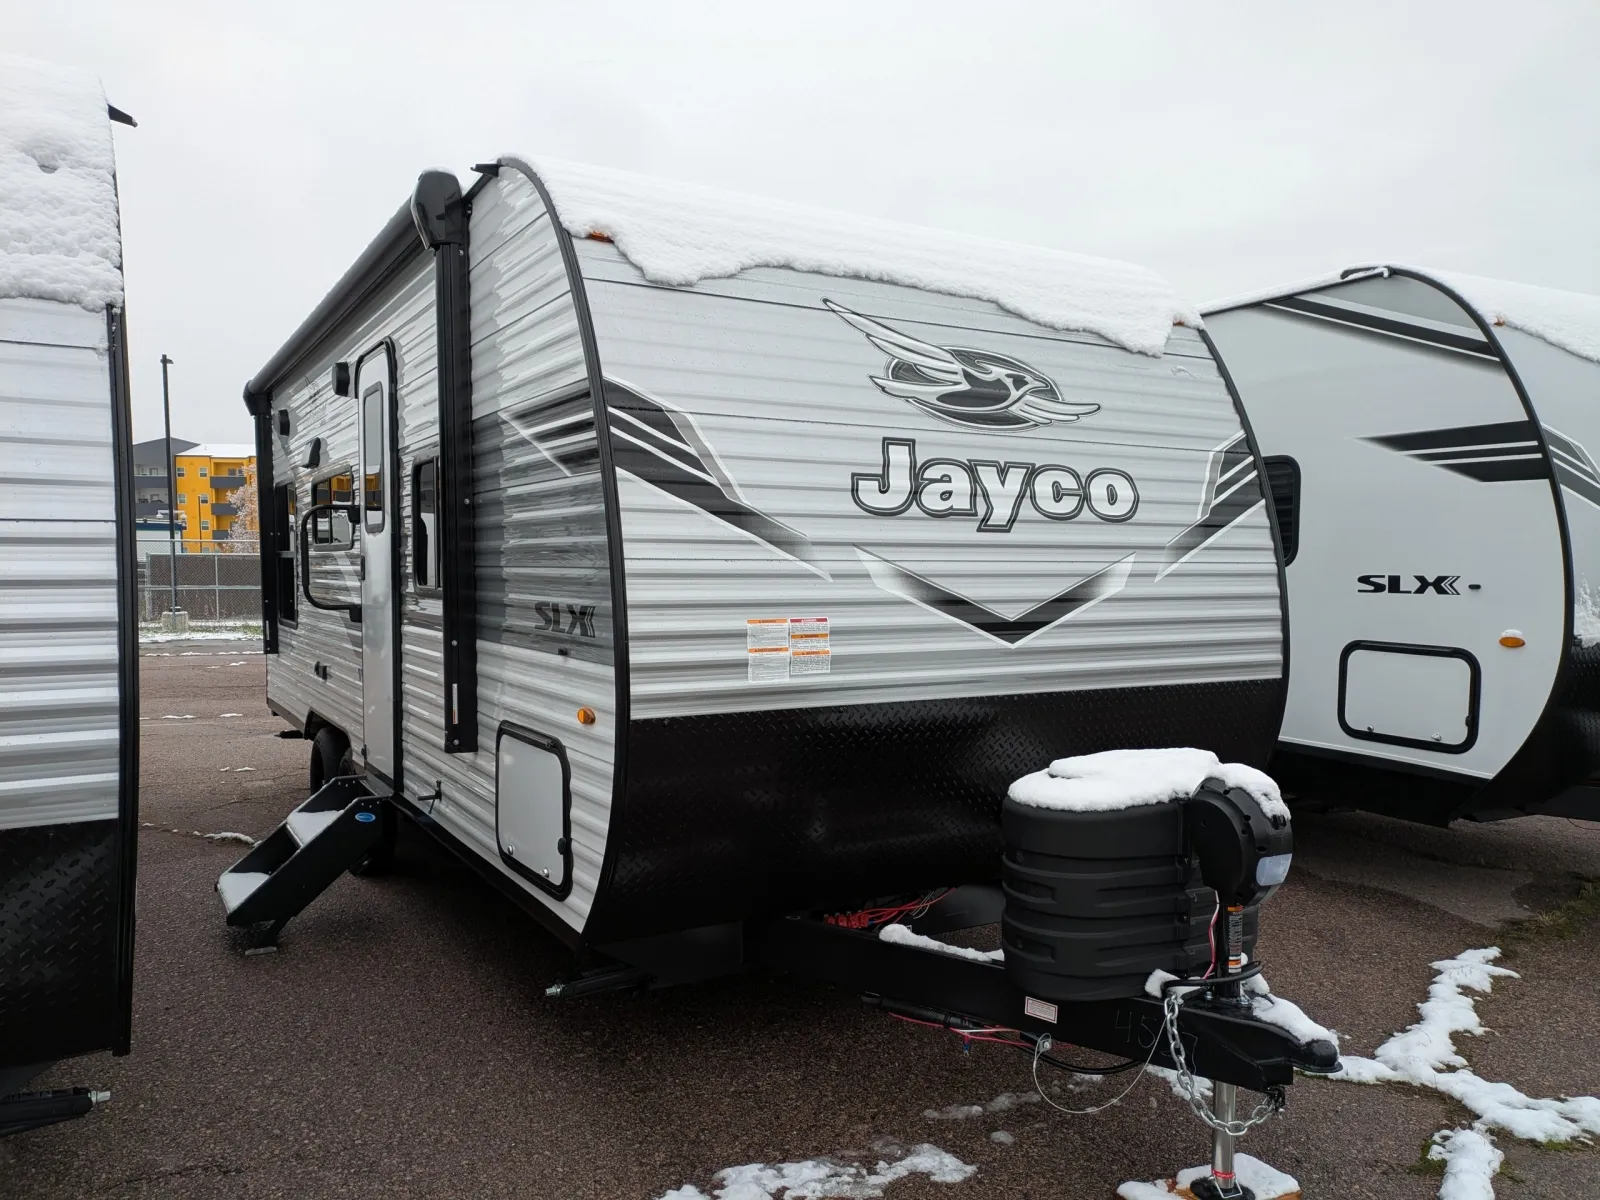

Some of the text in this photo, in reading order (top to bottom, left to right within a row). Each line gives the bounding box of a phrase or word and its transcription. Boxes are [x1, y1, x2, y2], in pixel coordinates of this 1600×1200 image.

[851, 437, 1140, 533] Jayco
[1357, 575, 1461, 595] SLX
[534, 601, 596, 638] SLX
[1115, 1008, 1198, 1075] 457
